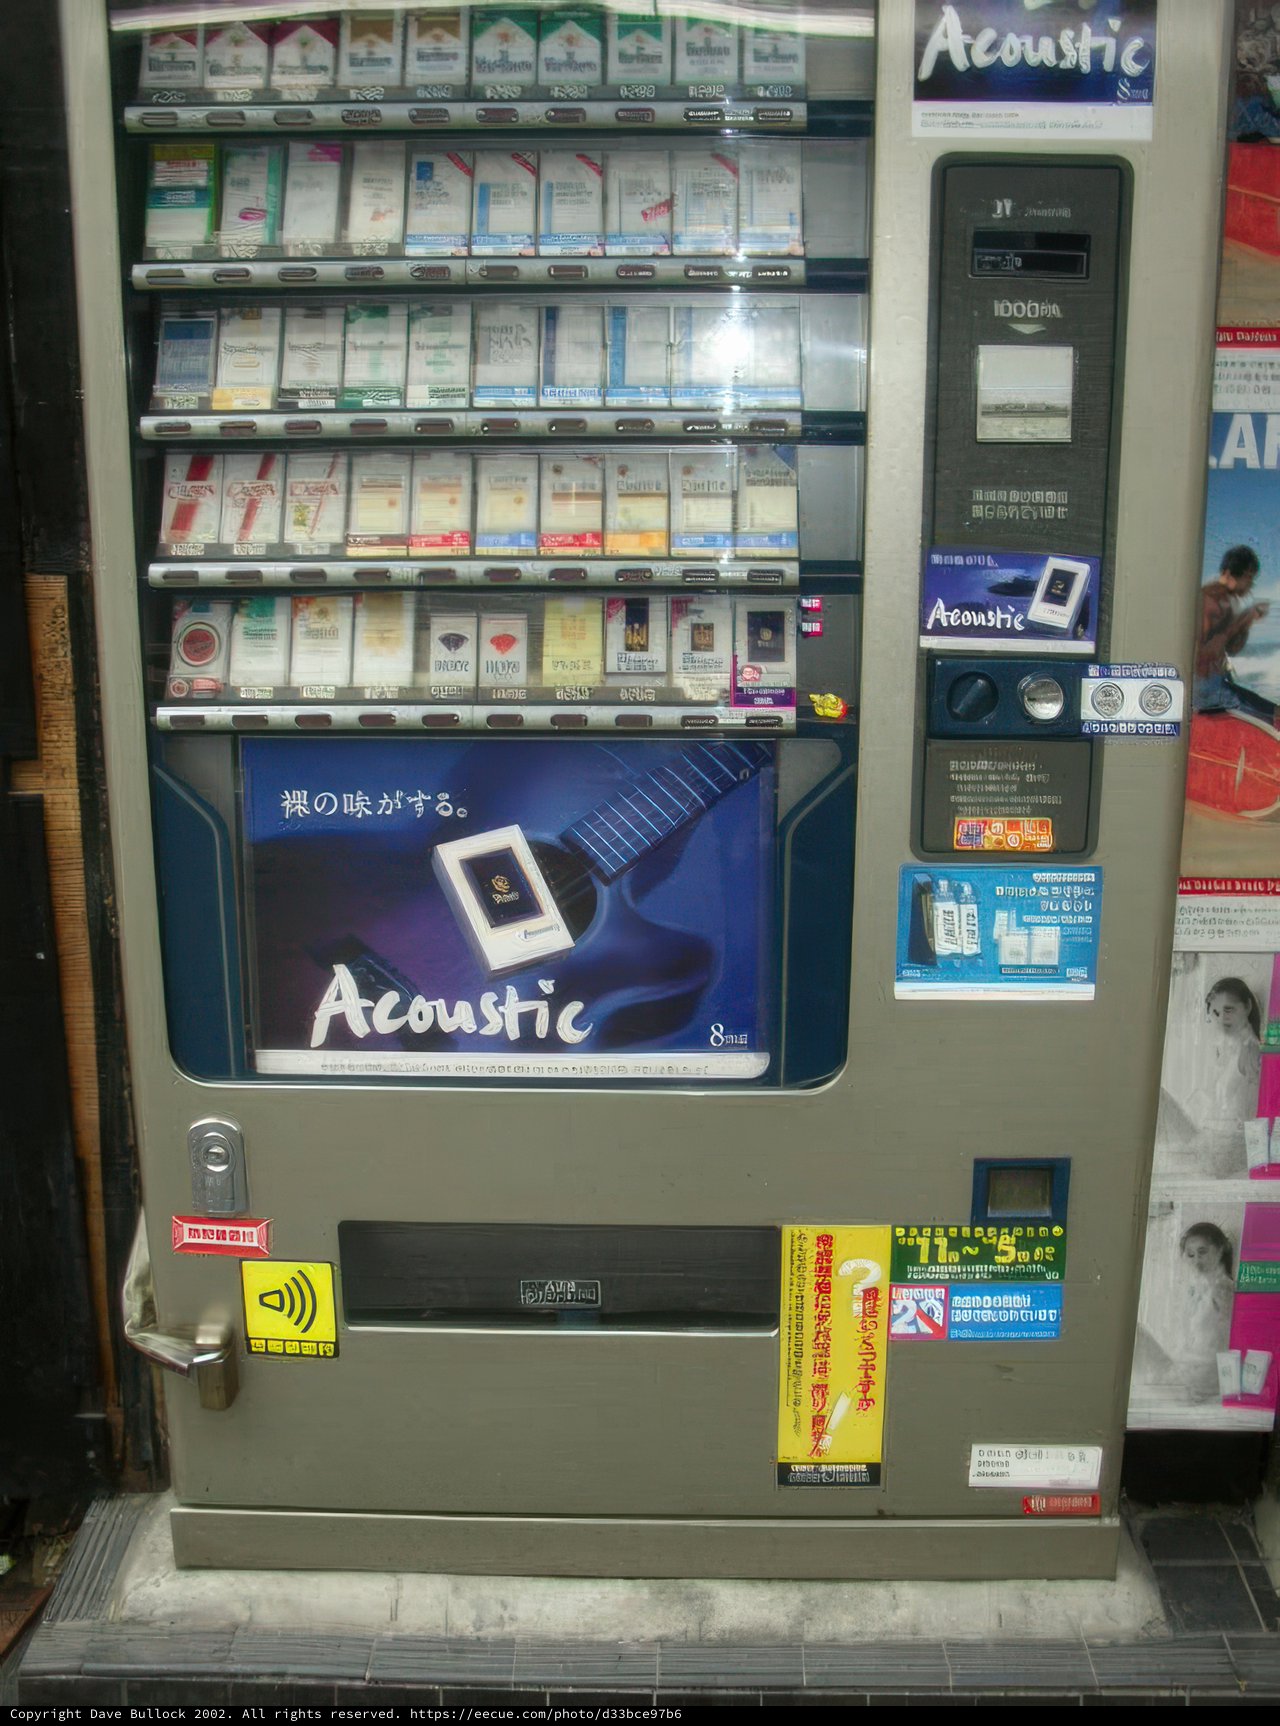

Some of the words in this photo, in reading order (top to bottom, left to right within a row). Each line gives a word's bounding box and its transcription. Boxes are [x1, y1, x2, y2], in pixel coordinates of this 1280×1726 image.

[918, 4, 1150, 81] Acoustic
[926, 598, 1025, 631] Acoustic
[281, 789, 468, 819] 裸の味がする。
[311, 963, 594, 1047] Acoustic
